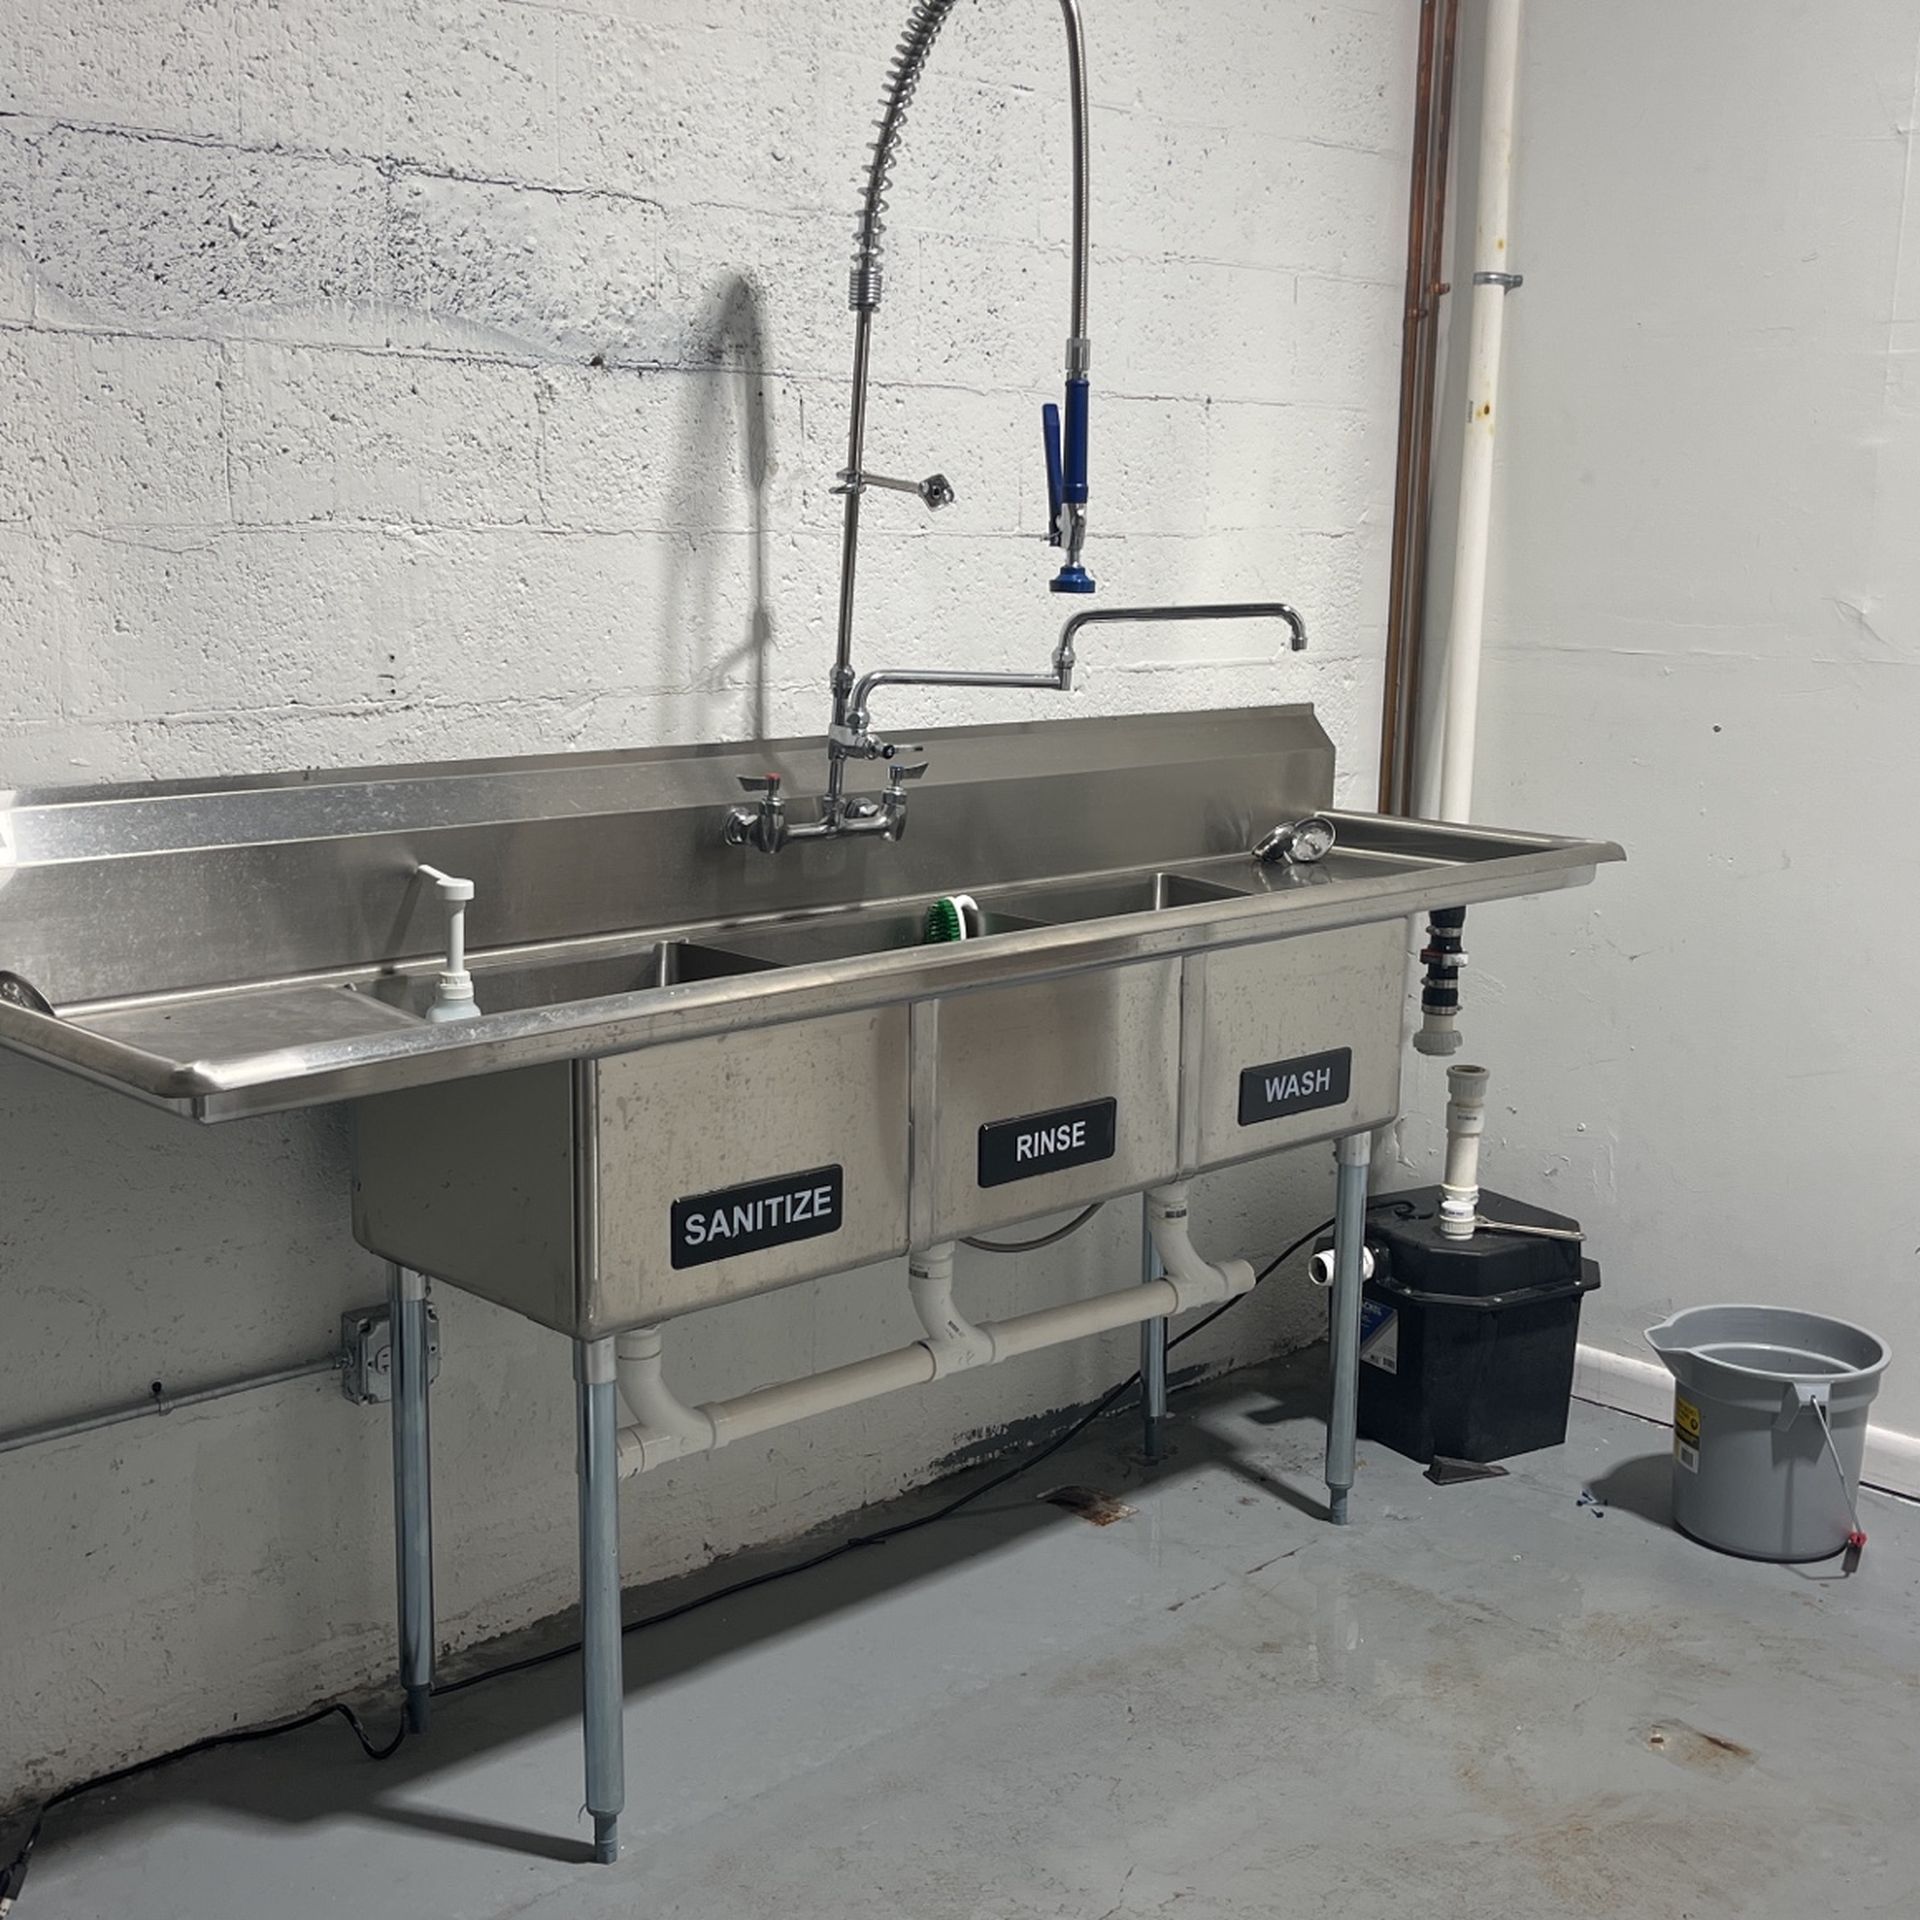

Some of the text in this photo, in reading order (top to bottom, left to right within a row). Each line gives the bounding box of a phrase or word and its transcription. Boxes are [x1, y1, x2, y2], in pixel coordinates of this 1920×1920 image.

[1265, 1067, 1331, 1103] WASH
[1016, 1120, 1086, 1162] RINSE
[685, 1185, 832, 1247] SANITIZE
